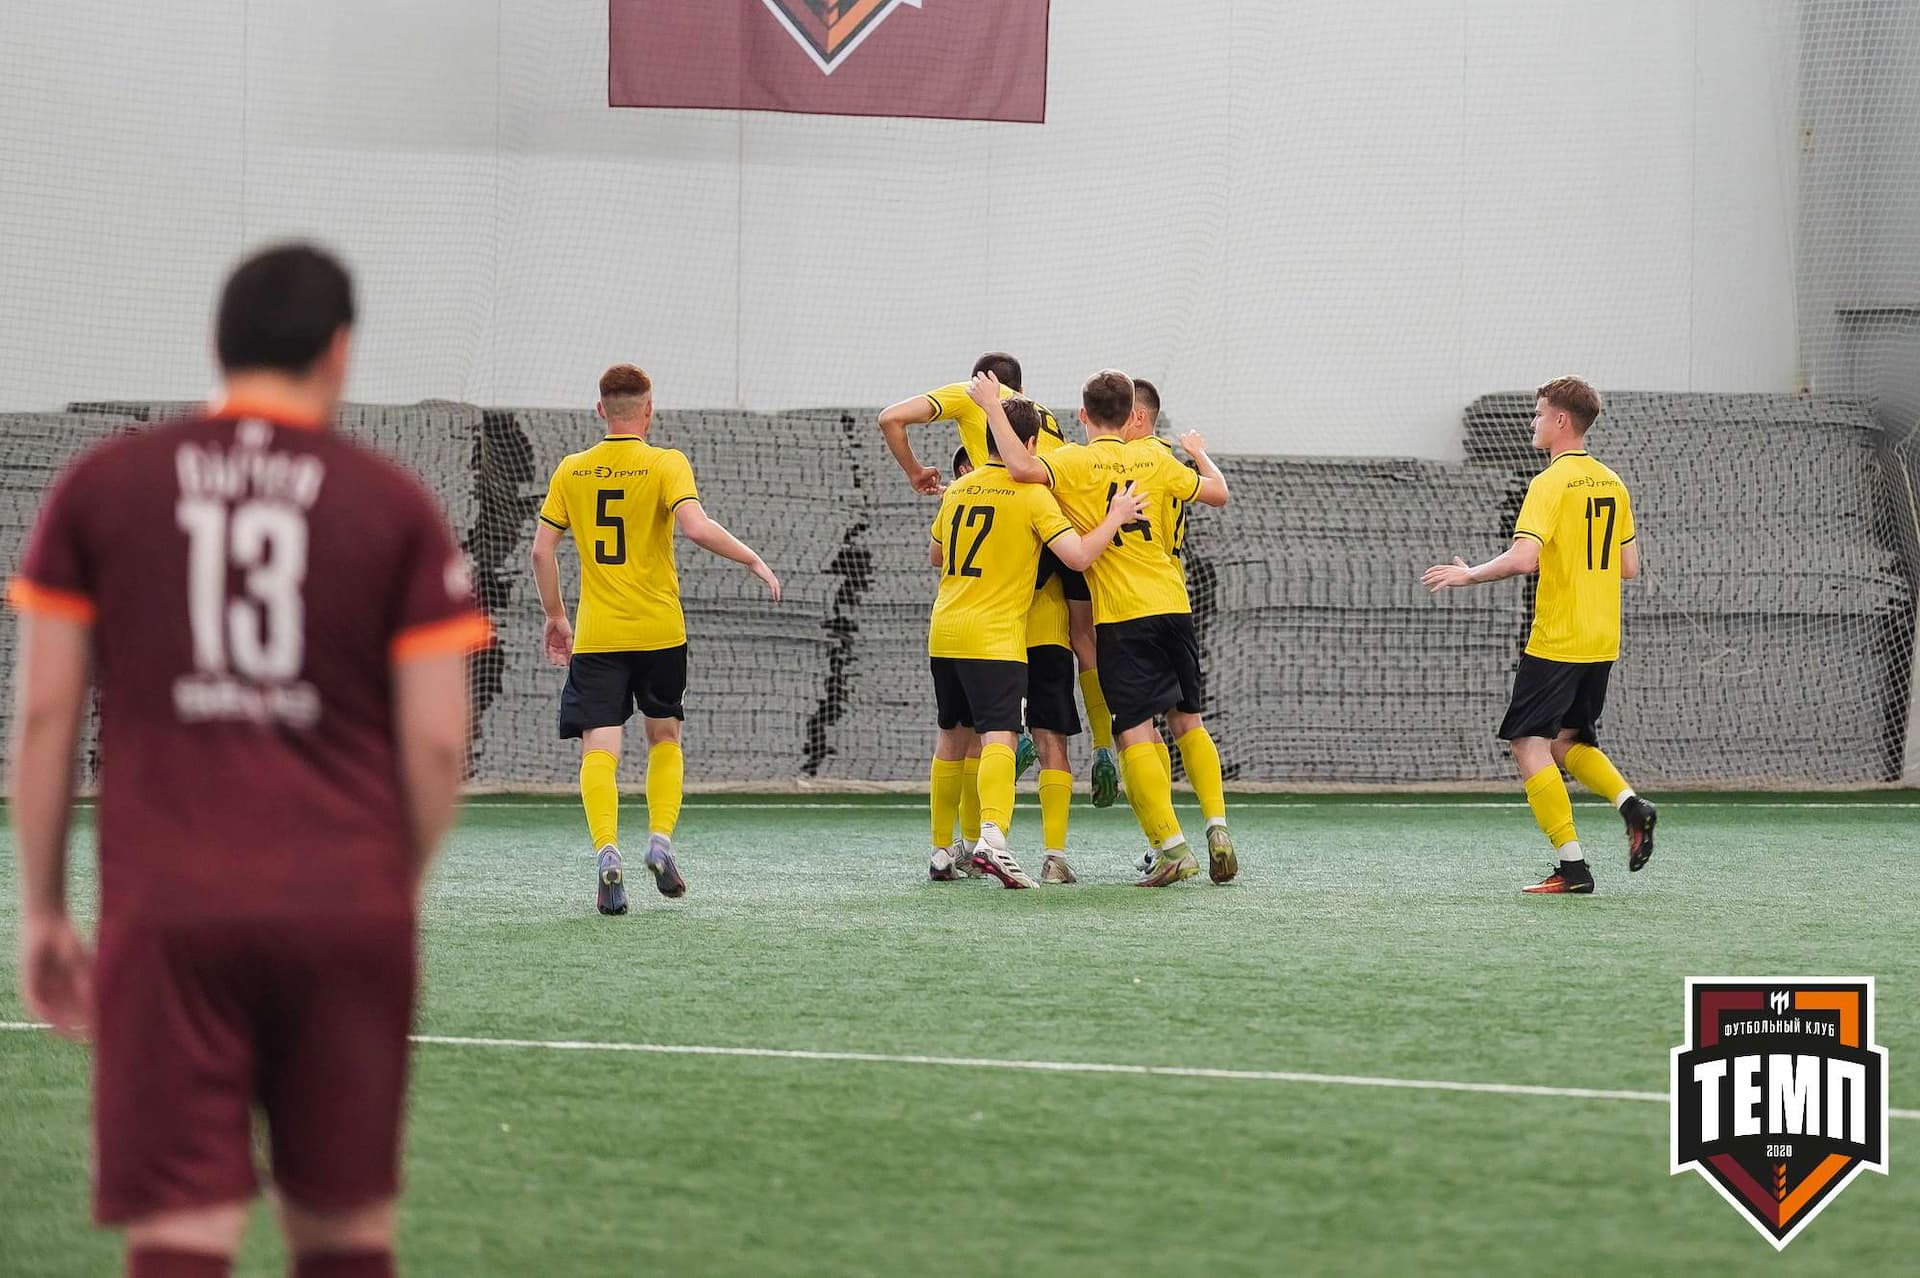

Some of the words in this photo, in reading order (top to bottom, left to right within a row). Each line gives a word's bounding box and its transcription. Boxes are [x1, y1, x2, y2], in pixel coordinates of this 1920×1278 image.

[595, 489, 626, 565] 5
[947, 504, 995, 577] 12
[1585, 497, 1616, 570] 17
[176, 500, 308, 678] 13
